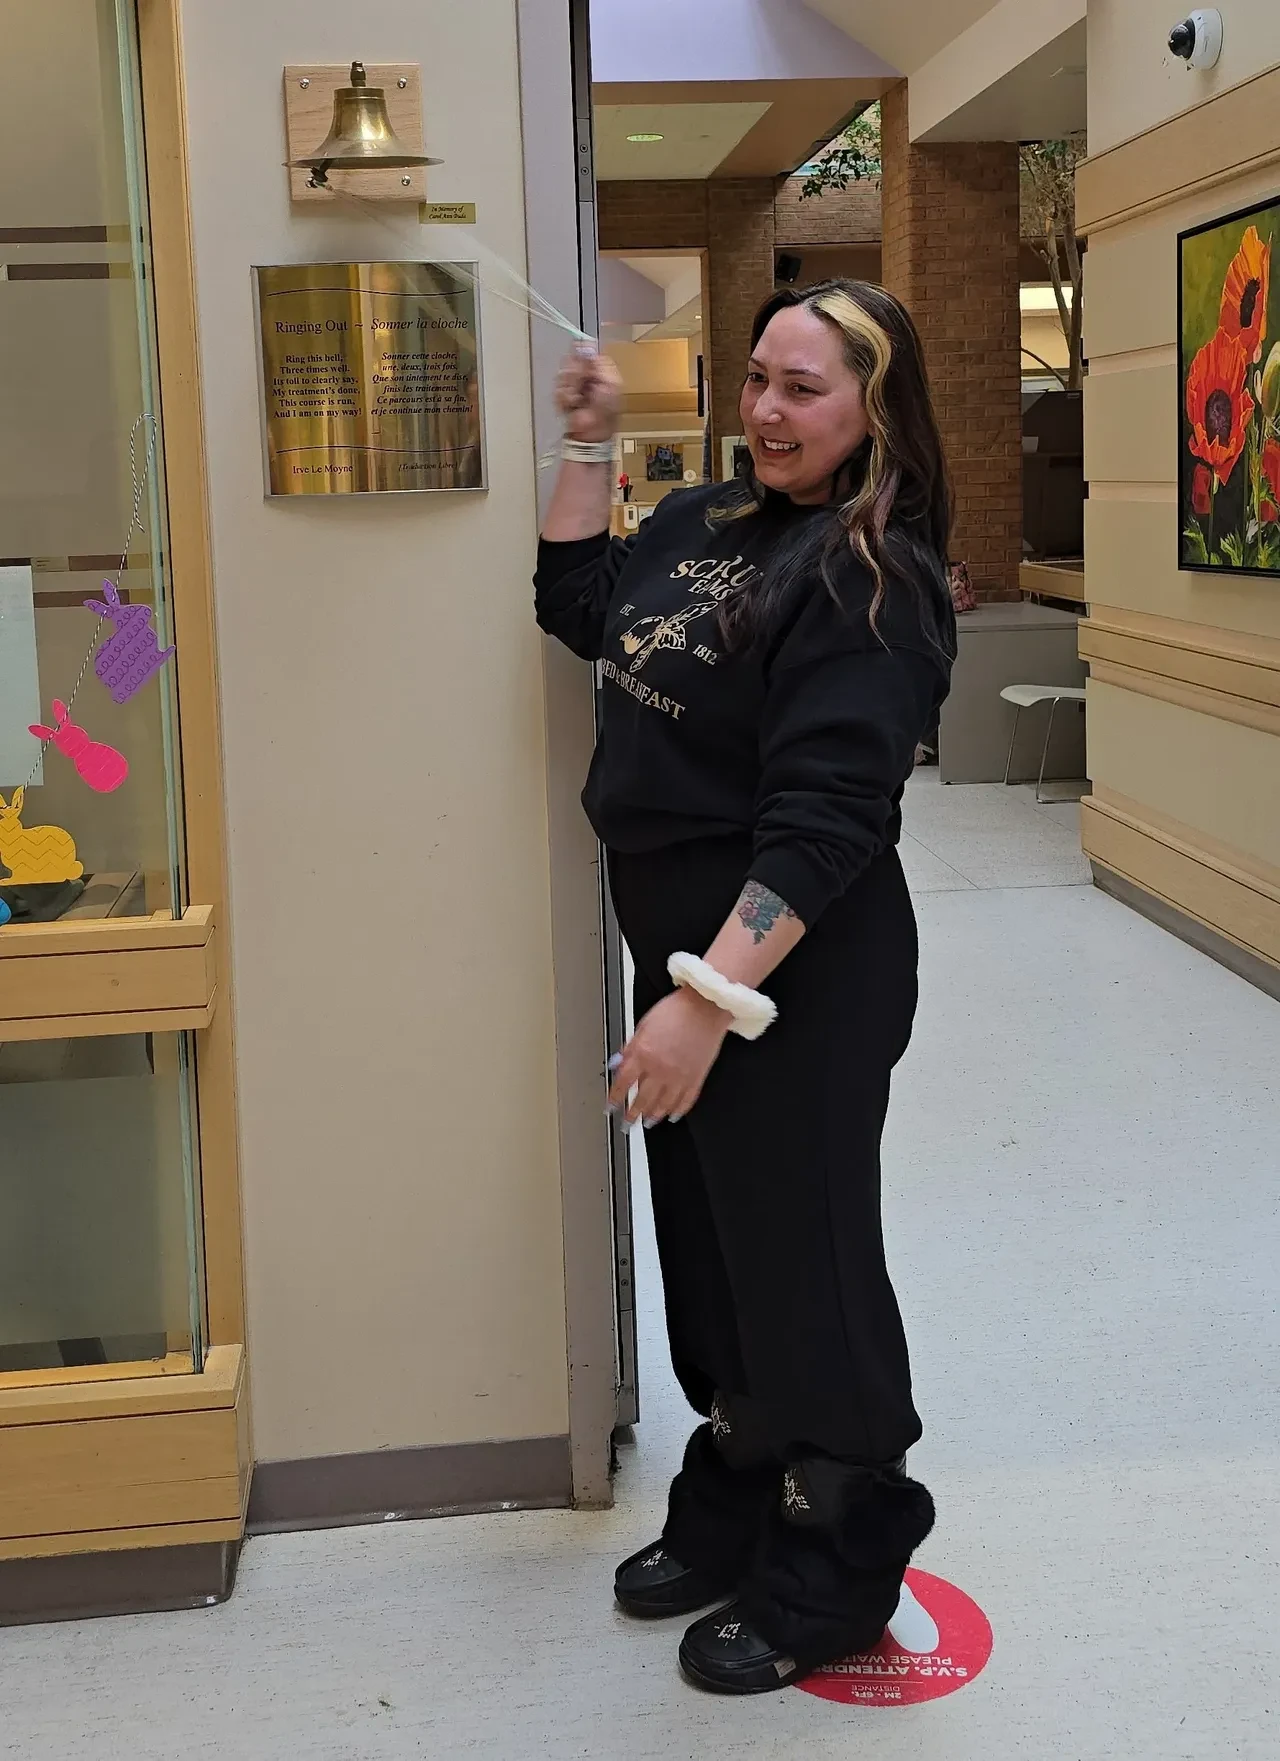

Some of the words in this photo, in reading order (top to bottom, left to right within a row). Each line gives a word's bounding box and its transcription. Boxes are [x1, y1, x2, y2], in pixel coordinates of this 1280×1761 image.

[458, 205, 464, 213] of
[275, 320, 322, 335] Ringing
[325, 319, 348, 331] Out
[371, 317, 414, 330] Sonner
[416, 317, 428, 329] la
[431, 317, 469, 329] cloche
[285, 354, 306, 364] Ring
[307, 354, 323, 363] this
[381, 352, 410, 360] Sonner
[411, 352, 429, 360] cette
[280, 366, 304, 374] Three
[306, 365, 328, 374] times
[423, 362, 440, 371] trois
[273, 377, 284, 386] Its
[286, 377, 299, 385] toll
[311, 375, 340, 385] clearly
[372, 373, 388, 384] Que
[406, 373, 442, 382] tintement
[272, 388, 285, 398] My
[288, 386, 336, 396] treatment's
[382, 384, 400, 394] finis
[402, 384, 413, 393] les
[279, 399, 297, 407] This
[298, 399, 326, 407] course
[328, 397, 335, 405] is
[376, 395, 387, 404] Ce
[388, 395, 423, 405] parcours
[425, 395, 436, 403] est
[273, 409, 290, 418] And
[326, 410, 340, 418] my
[342, 407, 362, 417] way!
[370, 407, 378, 415] et
[378, 407, 386, 416] je
[388, 406, 422, 415] continue
[423, 406, 440, 414] mon
[442, 404, 473, 413] chemin!
[293, 465, 310, 474] Irve
[311, 465, 322, 473] Le
[324, 464, 353, 474] Moyne
[692, 644, 717, 666] 1812
[601, 657, 617, 679] BED
[843, 1654, 886, 1664] WAIT
[890, 1655, 952, 1665] PLEASE
[914, 1665, 968, 1677] S.V.P.
